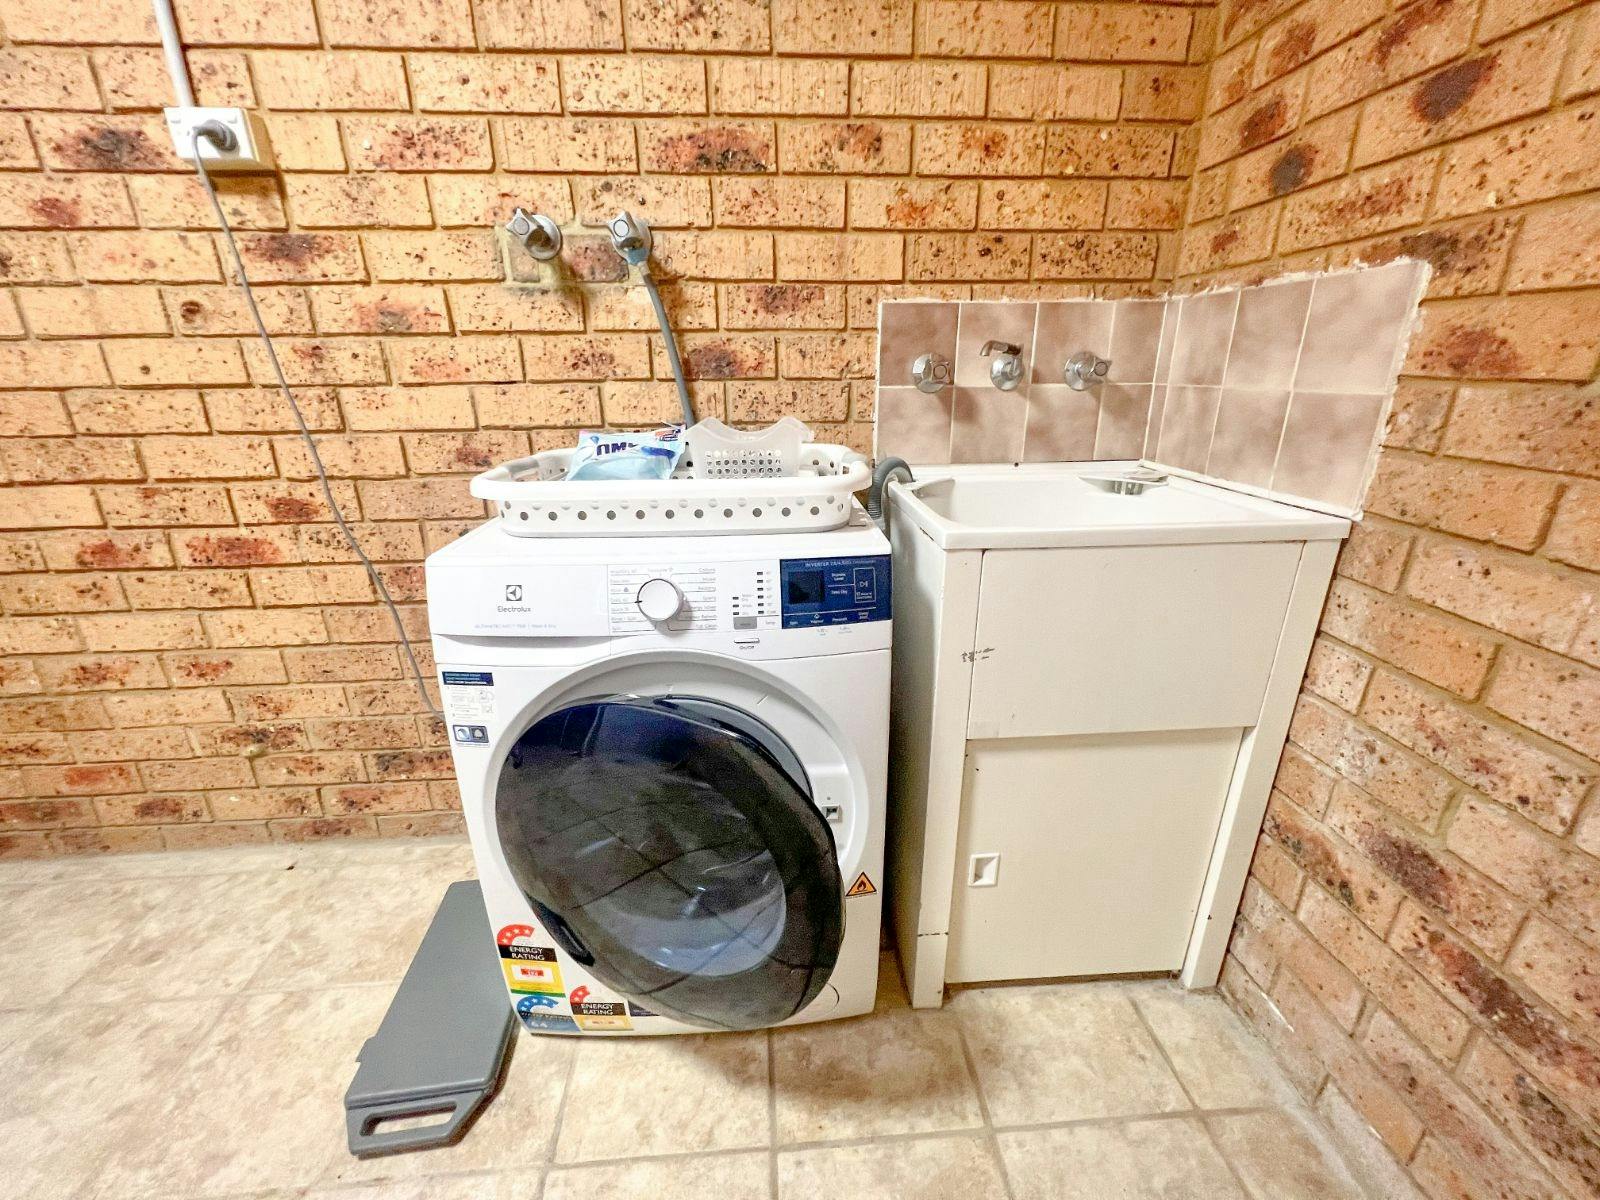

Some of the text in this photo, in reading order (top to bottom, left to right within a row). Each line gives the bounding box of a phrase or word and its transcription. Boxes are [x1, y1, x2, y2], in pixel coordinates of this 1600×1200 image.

[497, 605, 532, 613] Electrolux
[509, 946, 544, 954] ENERGY
[511, 952, 545, 961] RATING
[580, 1003, 615, 1011] ENERGY
